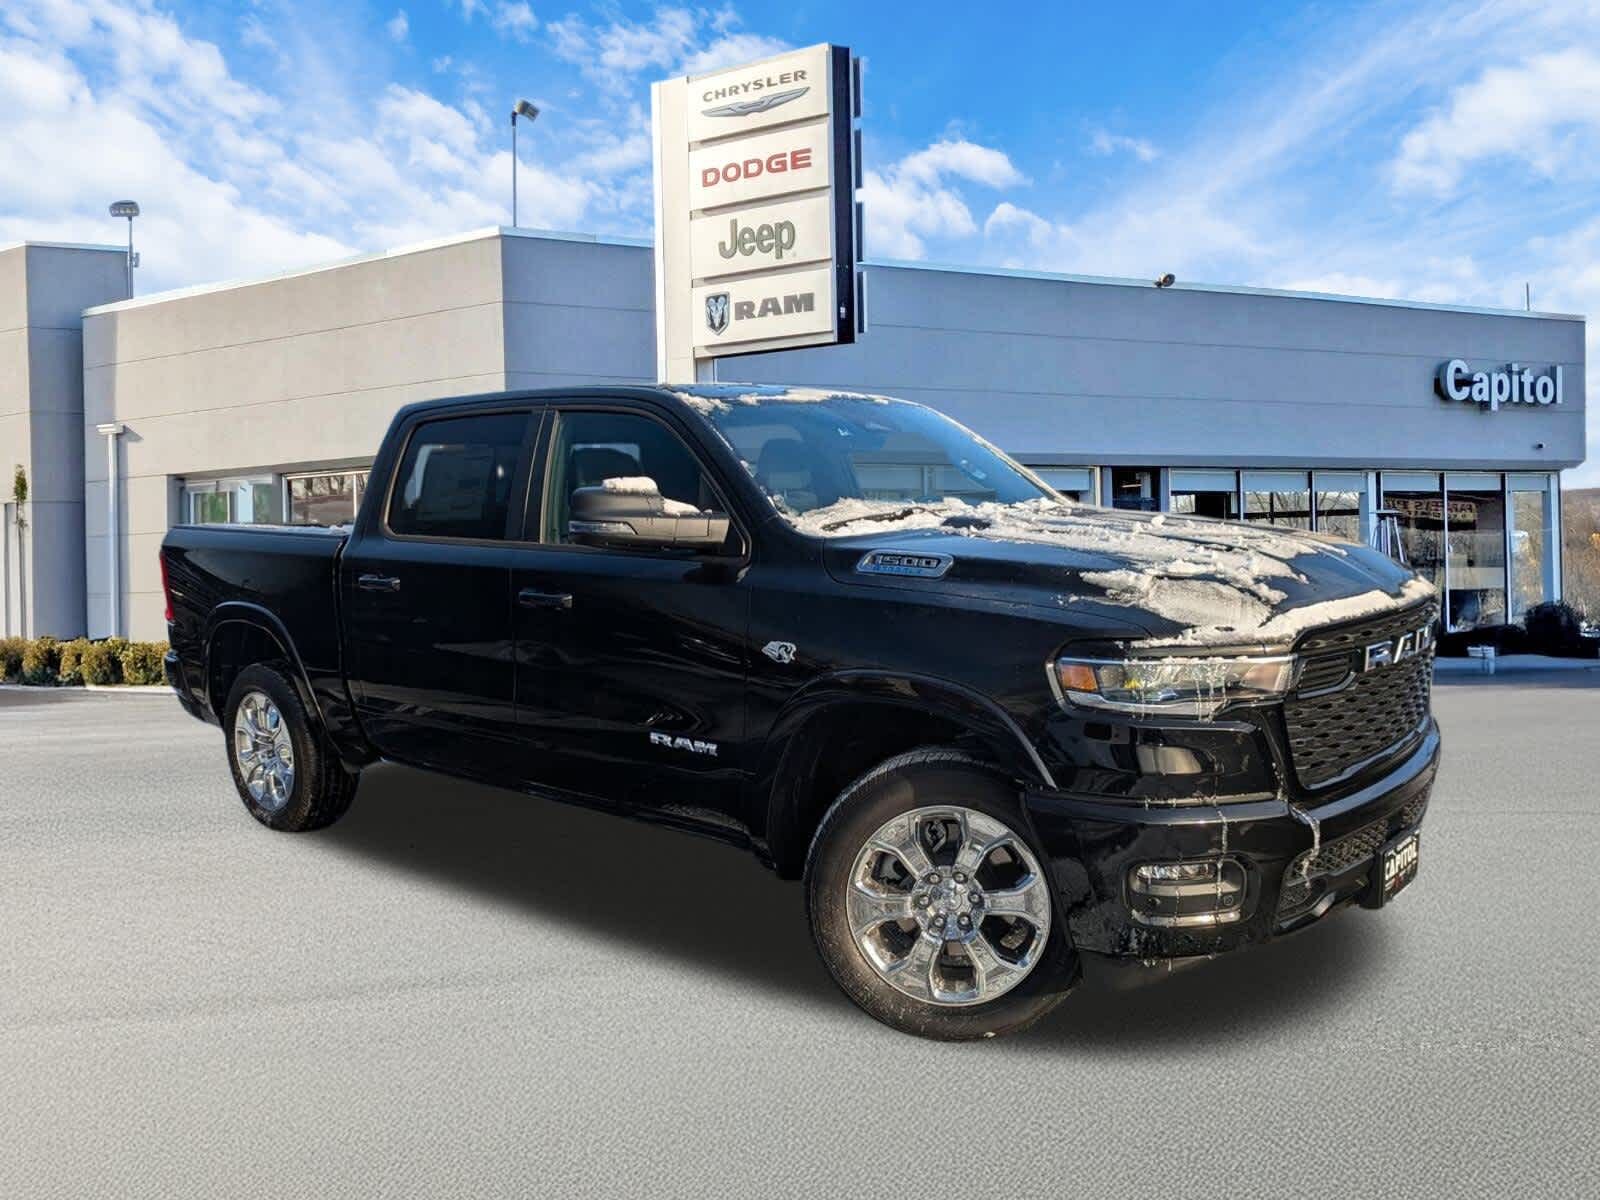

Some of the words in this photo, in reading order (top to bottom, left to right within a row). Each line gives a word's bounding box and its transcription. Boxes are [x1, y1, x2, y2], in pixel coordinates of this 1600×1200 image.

[702, 69, 808, 103] CHRYSLER
[701, 147, 813, 188] DODGE
[718, 218, 796, 260] Jeep
[734, 292, 815, 321] RAM
[1445, 358, 1563, 412] Capitol
[877, 553, 941, 570] 1500
[649, 731, 718, 757] RAM
